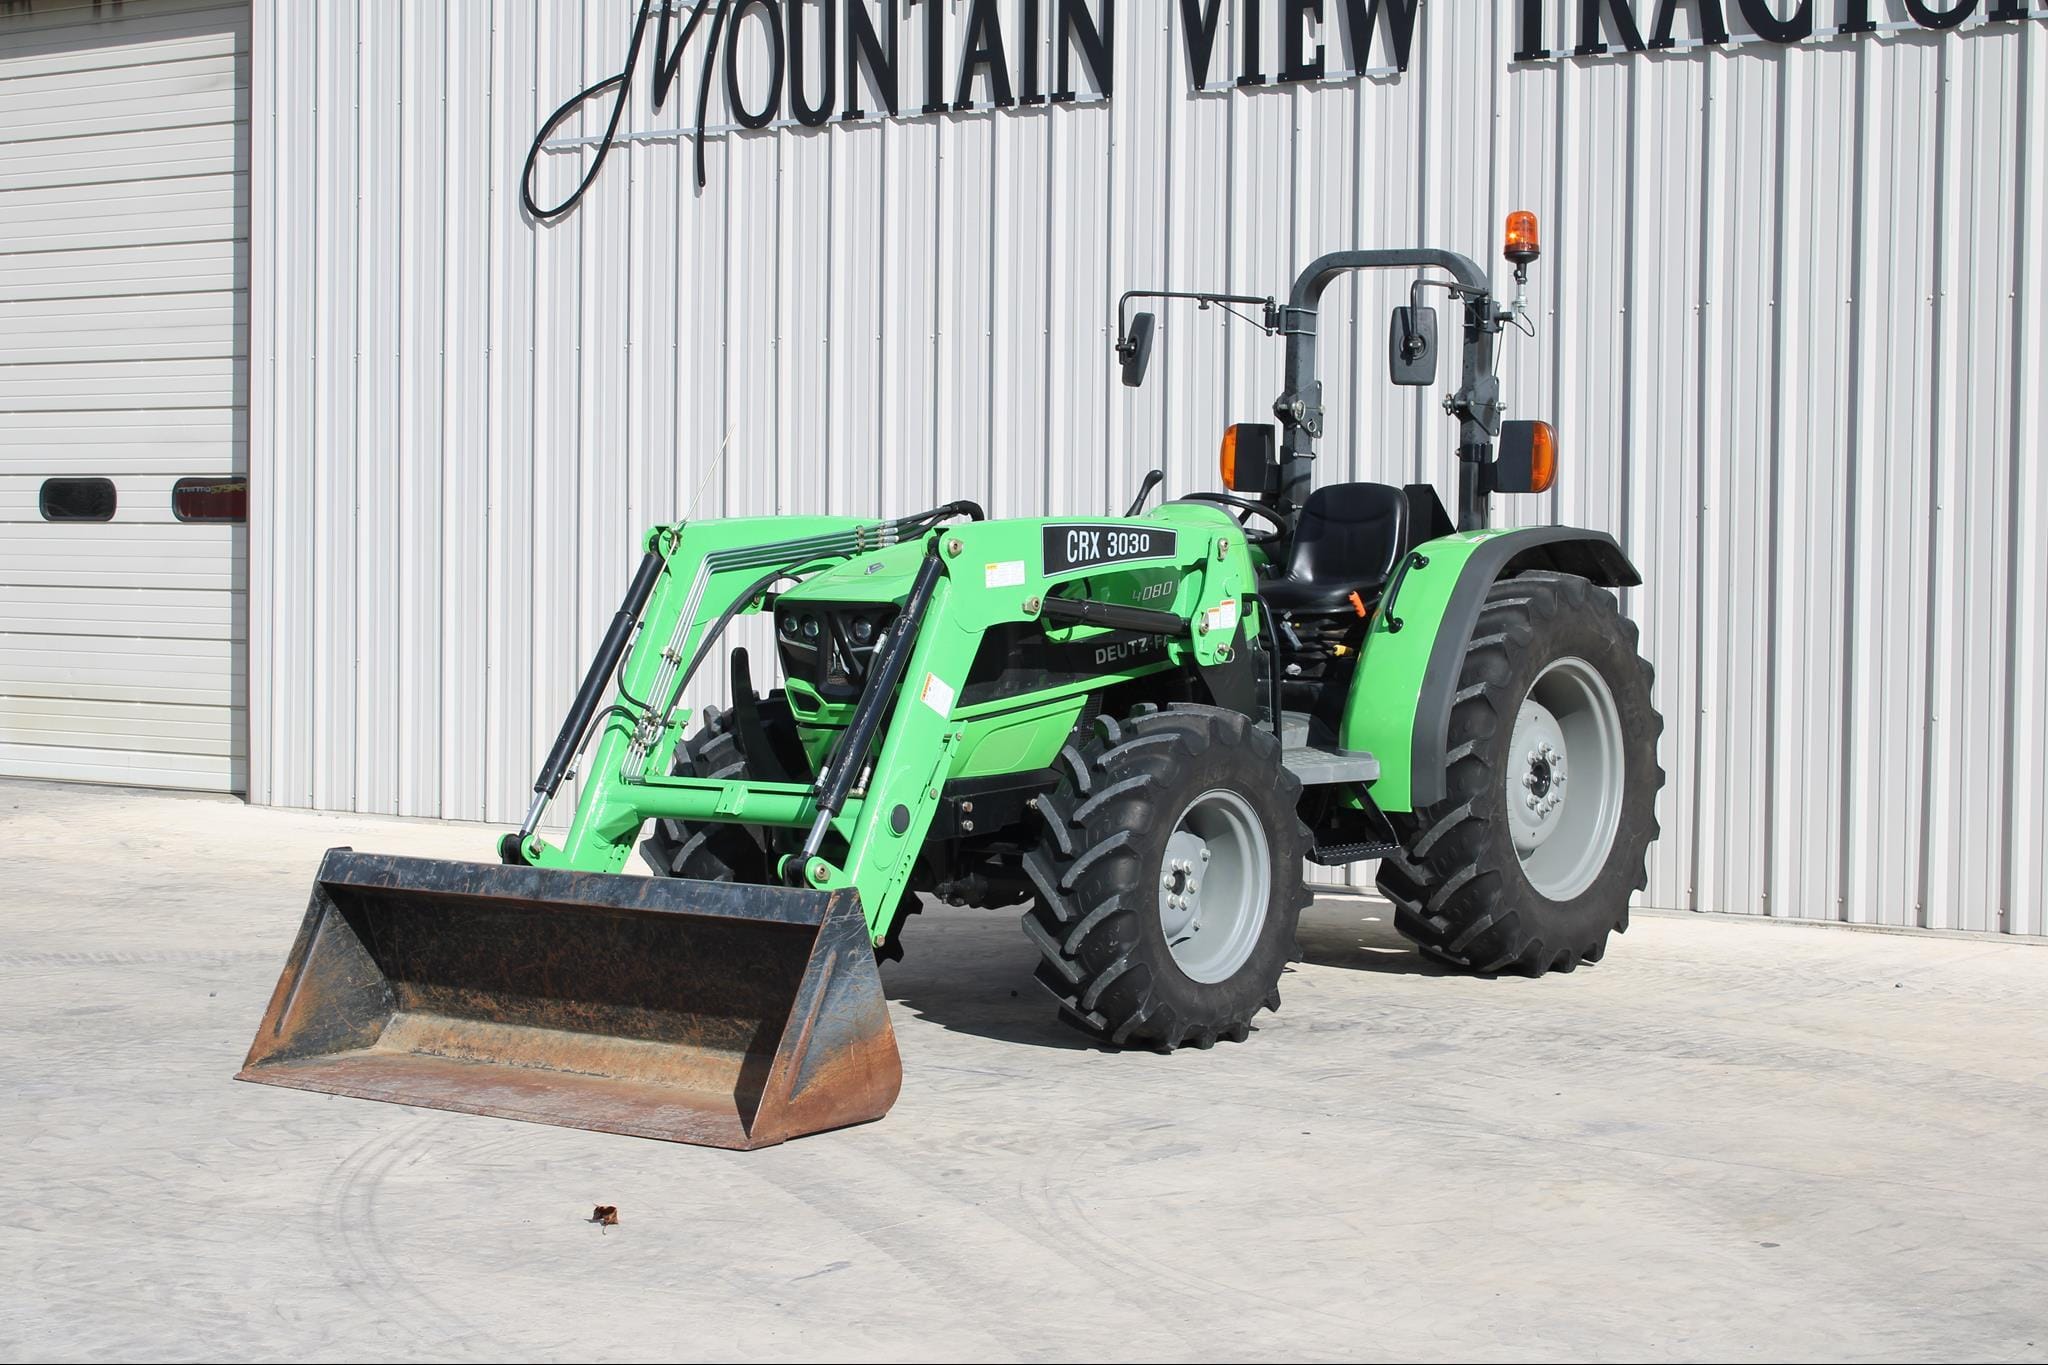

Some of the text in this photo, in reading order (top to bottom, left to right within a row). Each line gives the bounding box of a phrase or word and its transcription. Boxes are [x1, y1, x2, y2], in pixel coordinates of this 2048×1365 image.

[1067, 530, 1150, 562] CRX 3030
[1132, 581, 1173, 601] 4080
